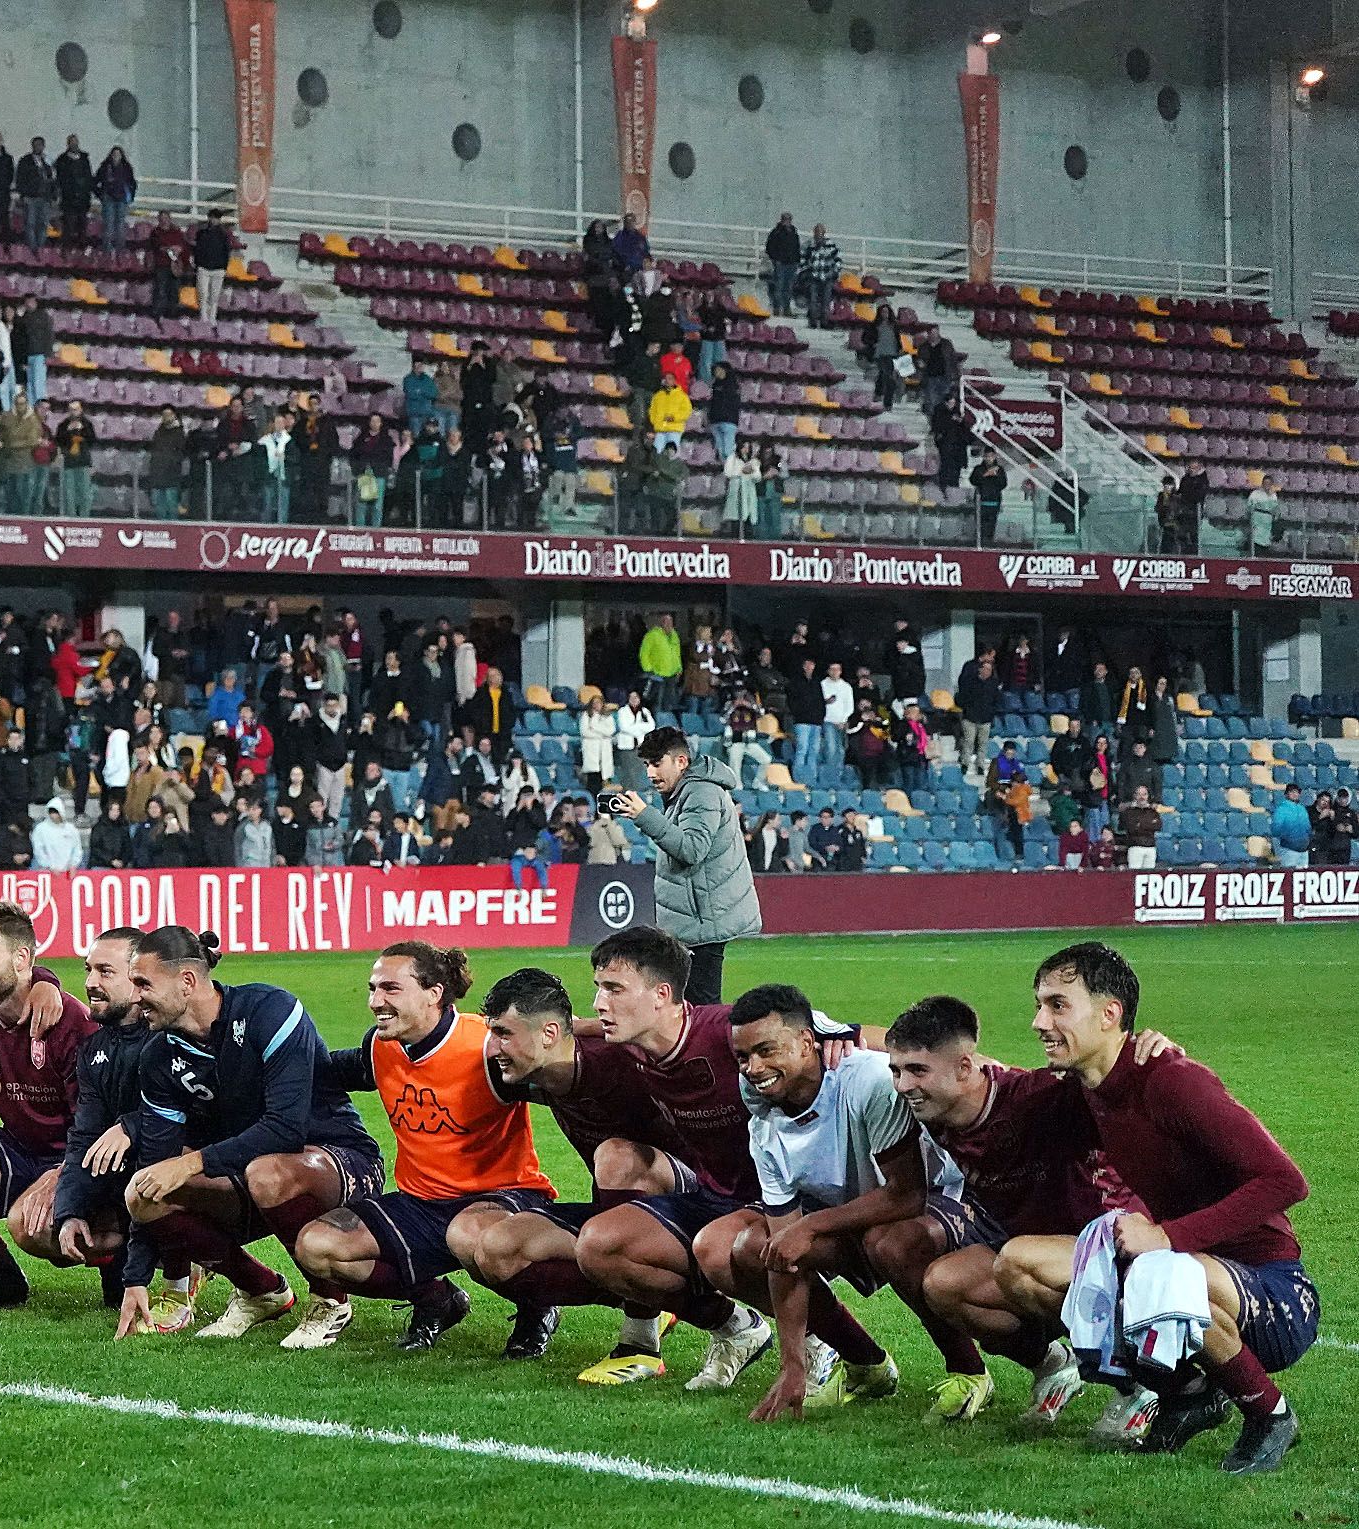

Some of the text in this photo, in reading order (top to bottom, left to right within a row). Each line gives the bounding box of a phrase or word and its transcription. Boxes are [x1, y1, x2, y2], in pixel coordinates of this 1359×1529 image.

[233, 528, 328, 572] sergraf
[1026, 555, 1075, 574] CORBA
[1139, 560, 1186, 579] CORBA
[1268, 575, 1353, 598] PESCAMAR
[1135, 873, 1206, 908] FROIZ
[1215, 872, 1286, 907] FROIZ
[1293, 870, 1359, 904] FROIZ
[71, 872, 353, 957] COPA DEL REY
[383, 888, 558, 927] MAPFRE
[6, 1082, 57, 1094] eputación
[181, 1071, 214, 1100] 5
